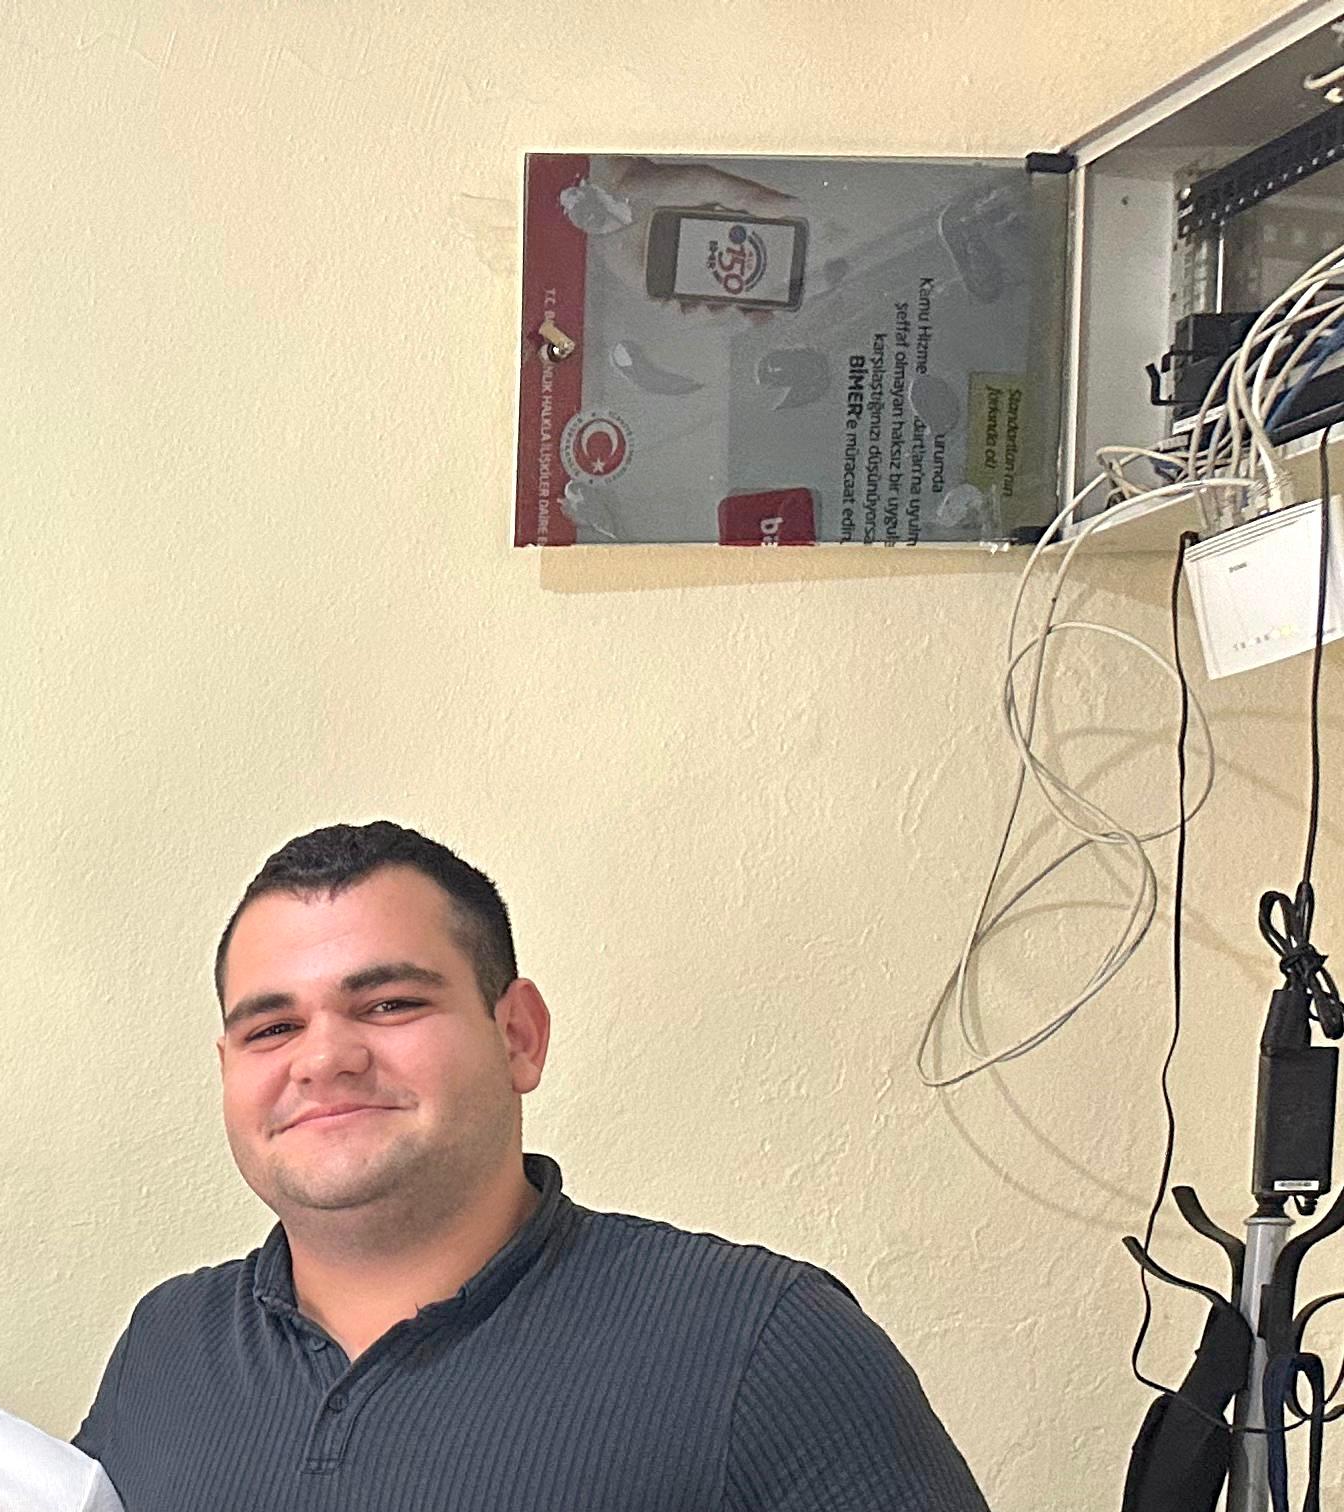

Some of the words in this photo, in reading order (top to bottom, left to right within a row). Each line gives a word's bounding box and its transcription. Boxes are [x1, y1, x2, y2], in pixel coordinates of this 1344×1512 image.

[717, 245, 747, 295] 150
[917, 277, 935, 322] Kamu
[894, 302, 911, 349] şeffaf
[915, 325, 933, 376] Hizme
[889, 351, 909, 417] olmayan
[540, 395, 553, 442] HALKLA
[841, 432, 860, 505] müracaat
[889, 420, 906, 470] haksız
[932, 432, 946, 493] urumda
[863, 445, 883, 545] düşünüyorsa
[887, 473, 904, 492] bir
[537, 499, 550, 535] DAİRE
